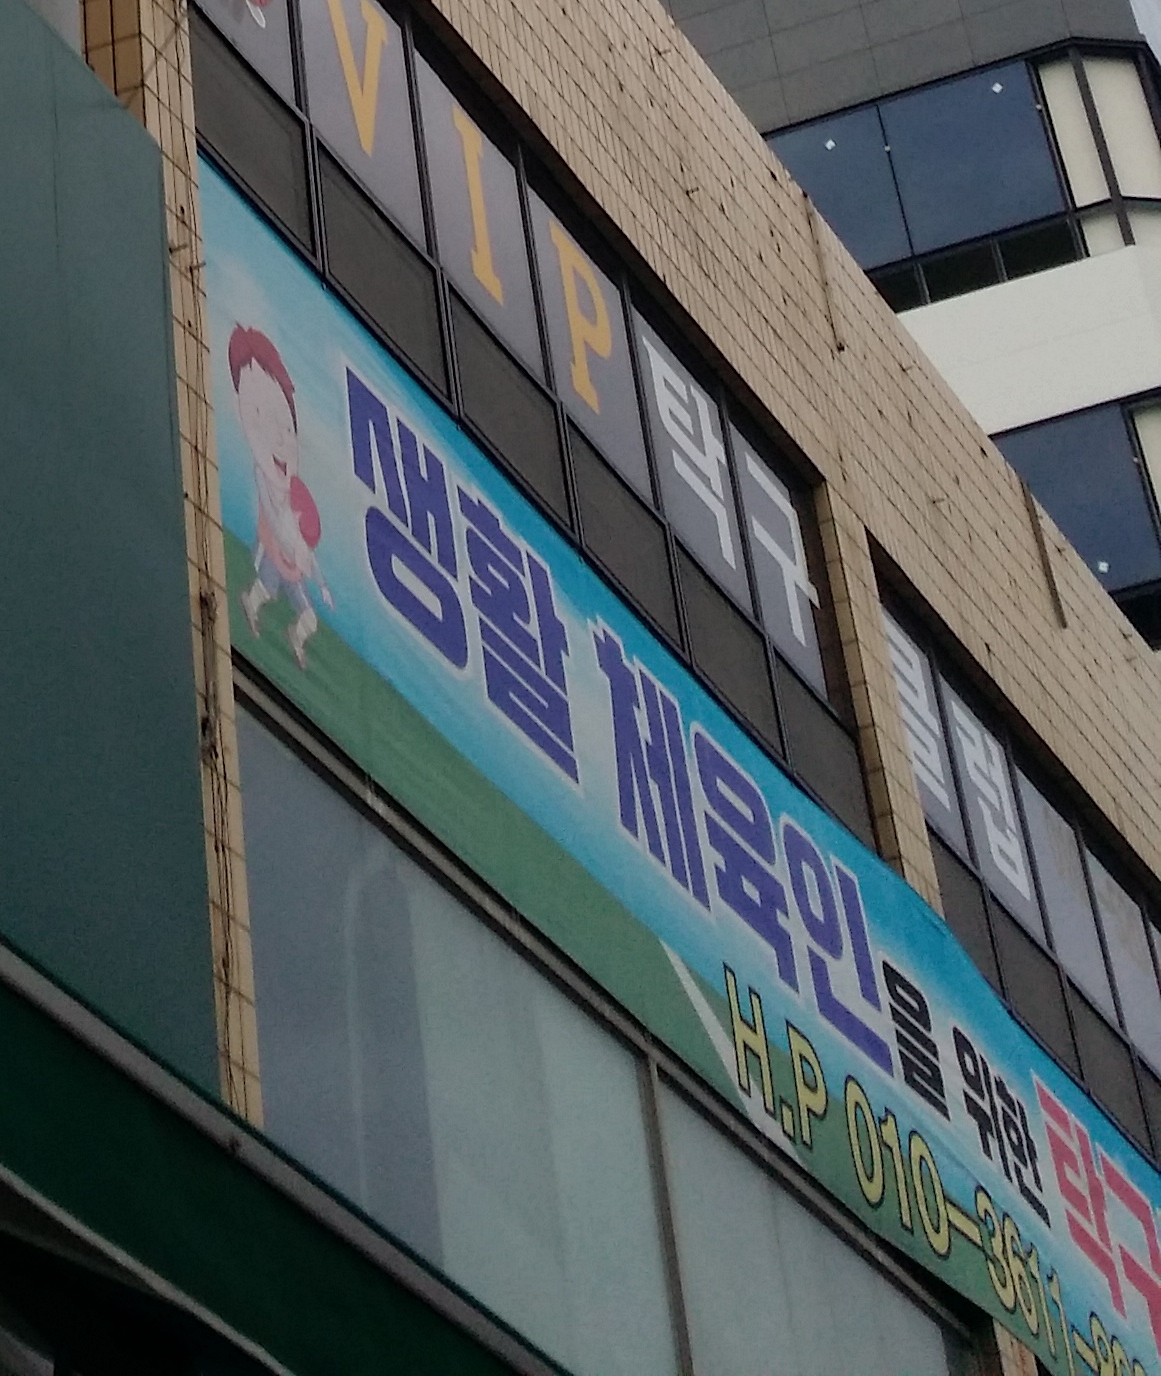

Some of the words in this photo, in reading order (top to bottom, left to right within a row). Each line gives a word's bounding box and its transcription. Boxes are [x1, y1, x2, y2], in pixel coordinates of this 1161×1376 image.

[642, 335, 820, 646] 탁구
[346, 366, 579, 785] 생활
[592, 626, 951, 1122] 체육인을
[953, 1025, 1052, 1229] 위한
[723, 961, 828, 1149] H.P
